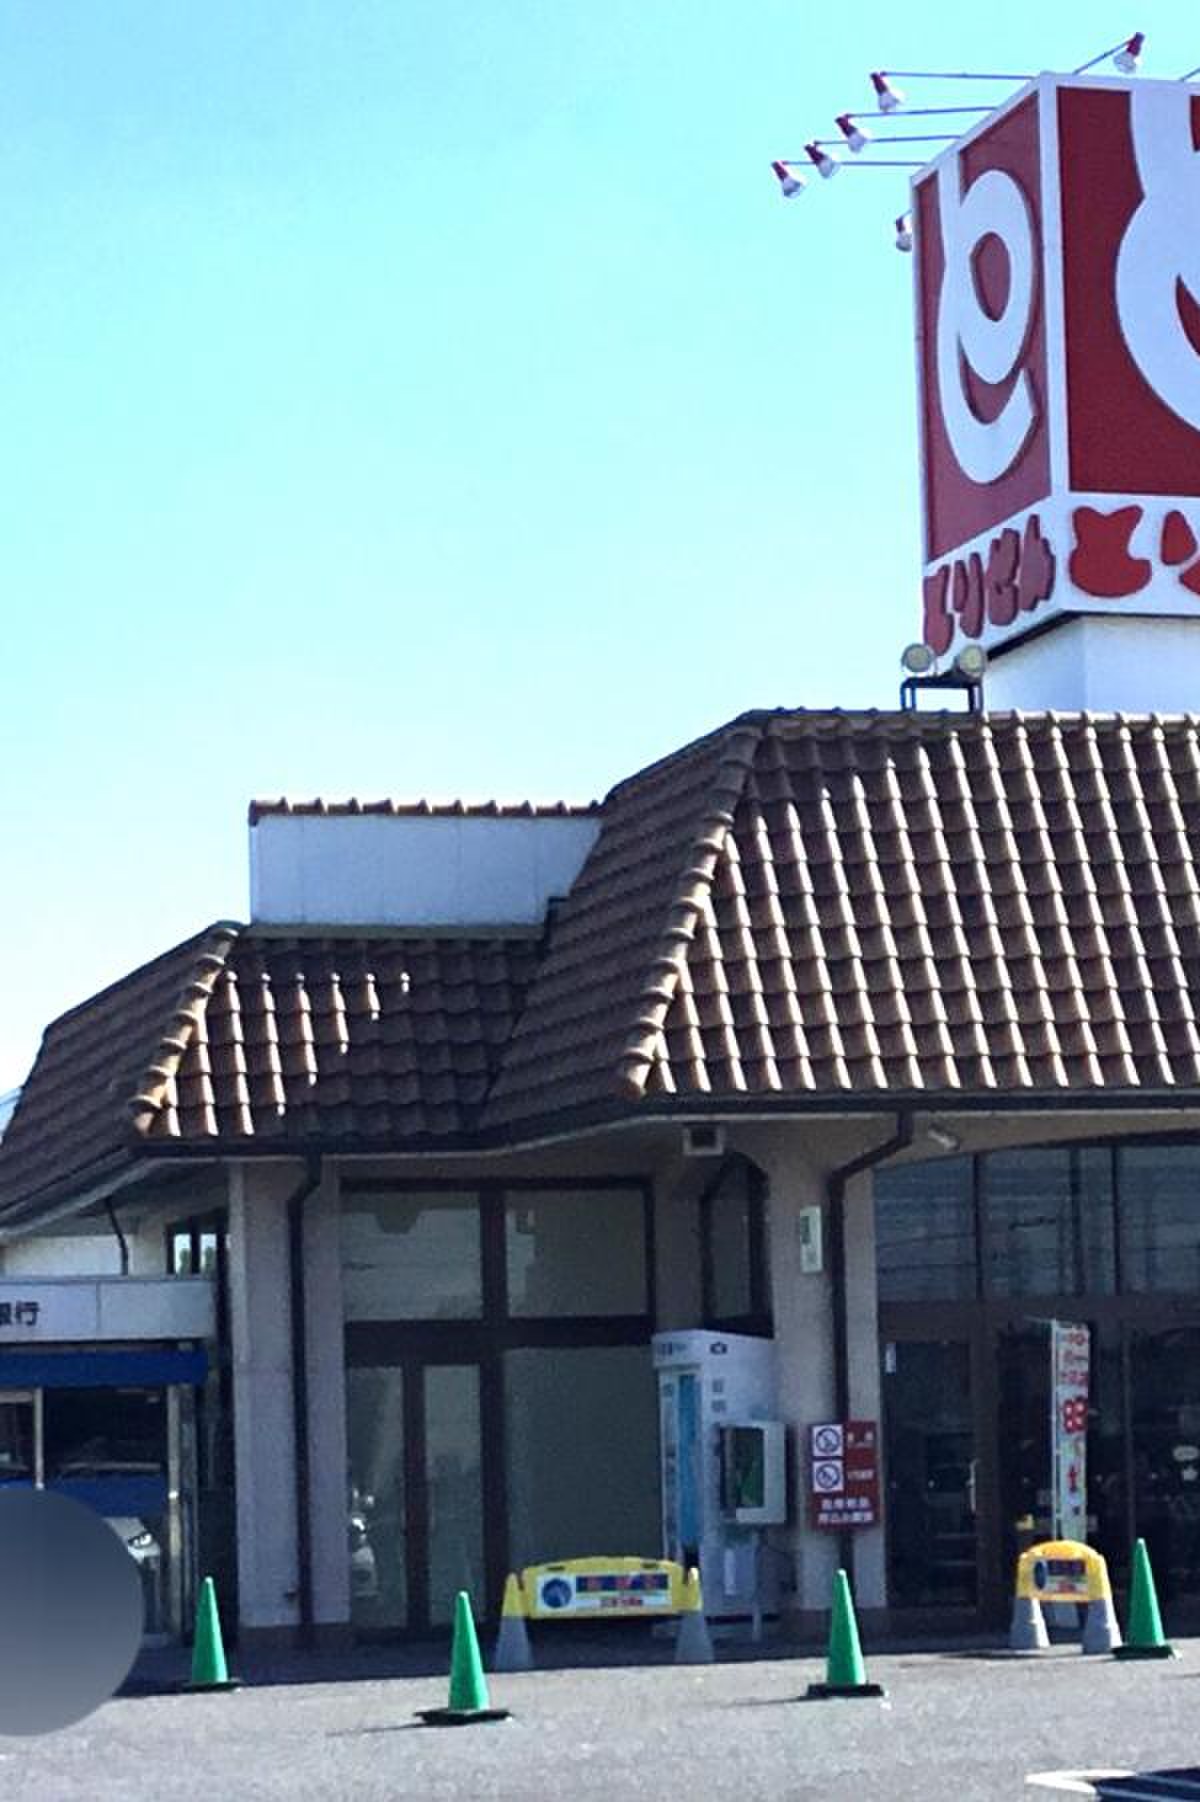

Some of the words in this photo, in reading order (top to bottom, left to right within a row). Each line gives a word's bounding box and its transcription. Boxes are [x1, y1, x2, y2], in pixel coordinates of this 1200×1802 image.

[937, 152, 1039, 485] と
[923, 513, 1056, 656] とりせん
